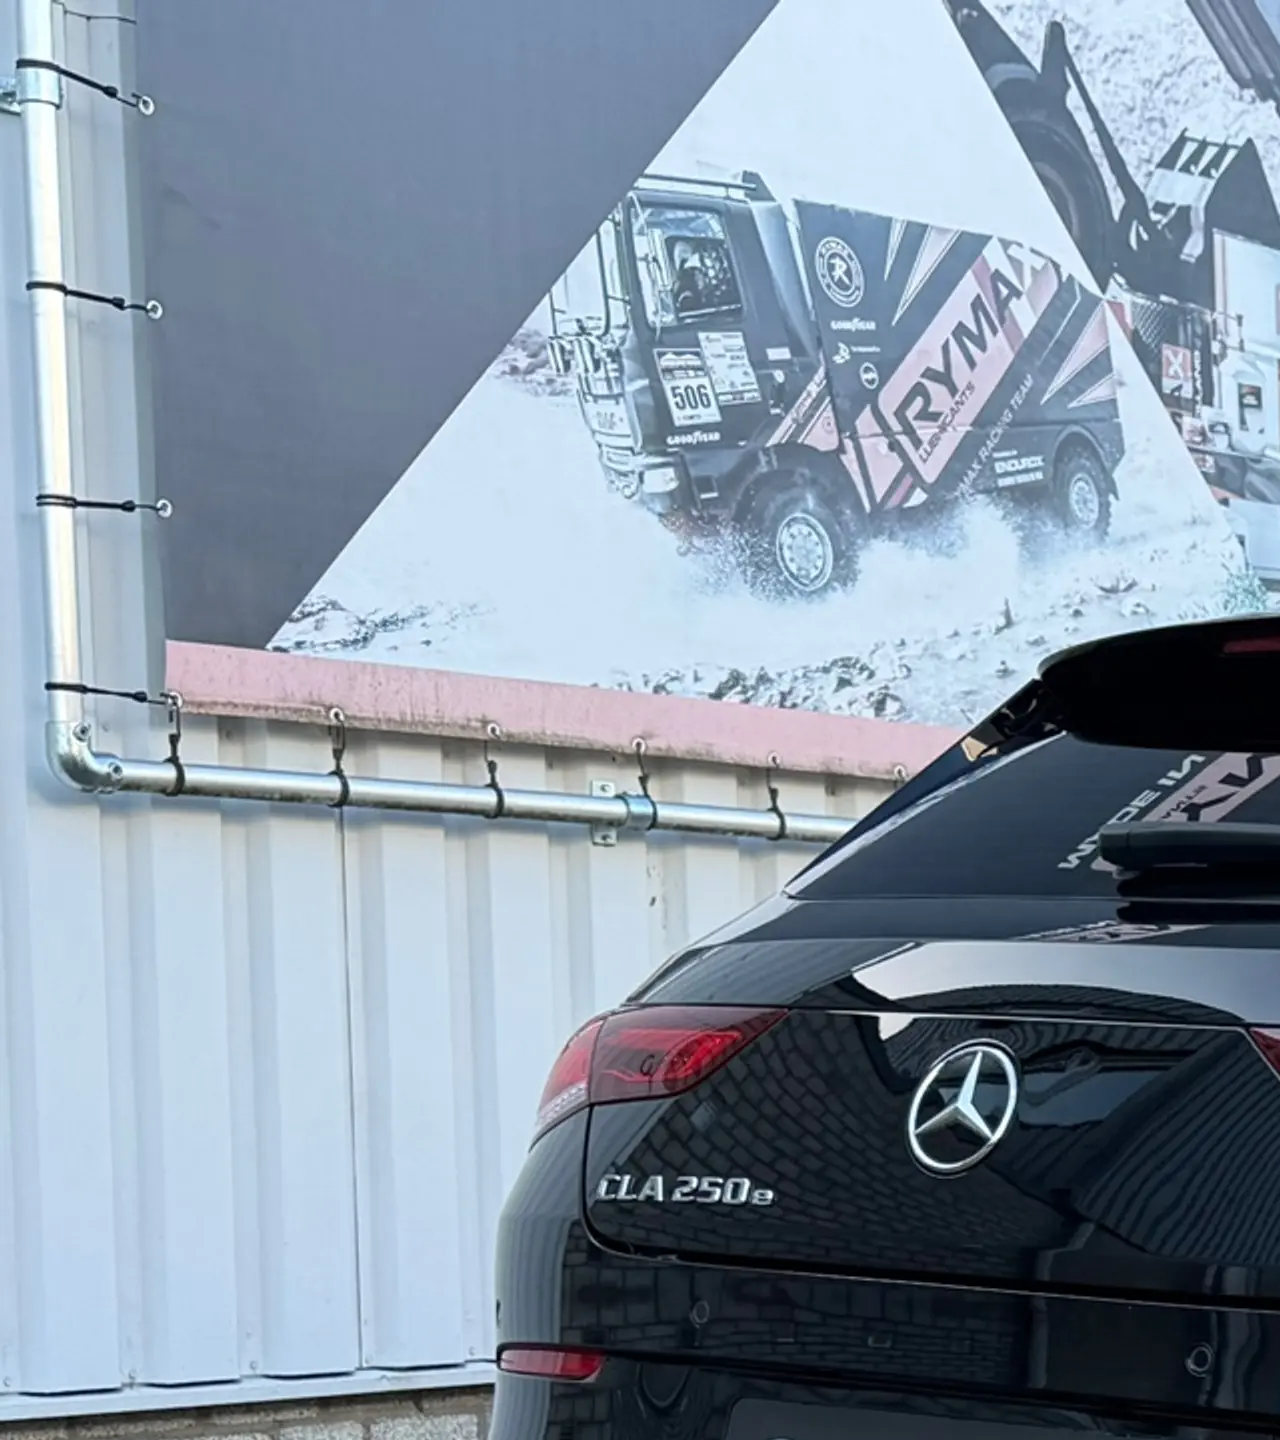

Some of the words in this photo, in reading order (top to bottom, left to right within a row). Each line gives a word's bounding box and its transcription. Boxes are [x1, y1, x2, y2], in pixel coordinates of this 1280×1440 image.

[670, 384, 712, 410] 506
[1010, 373, 1034, 410] TEAM
[596, 1174, 664, 1203] CLA
[671, 1175, 774, 1206] 250e
